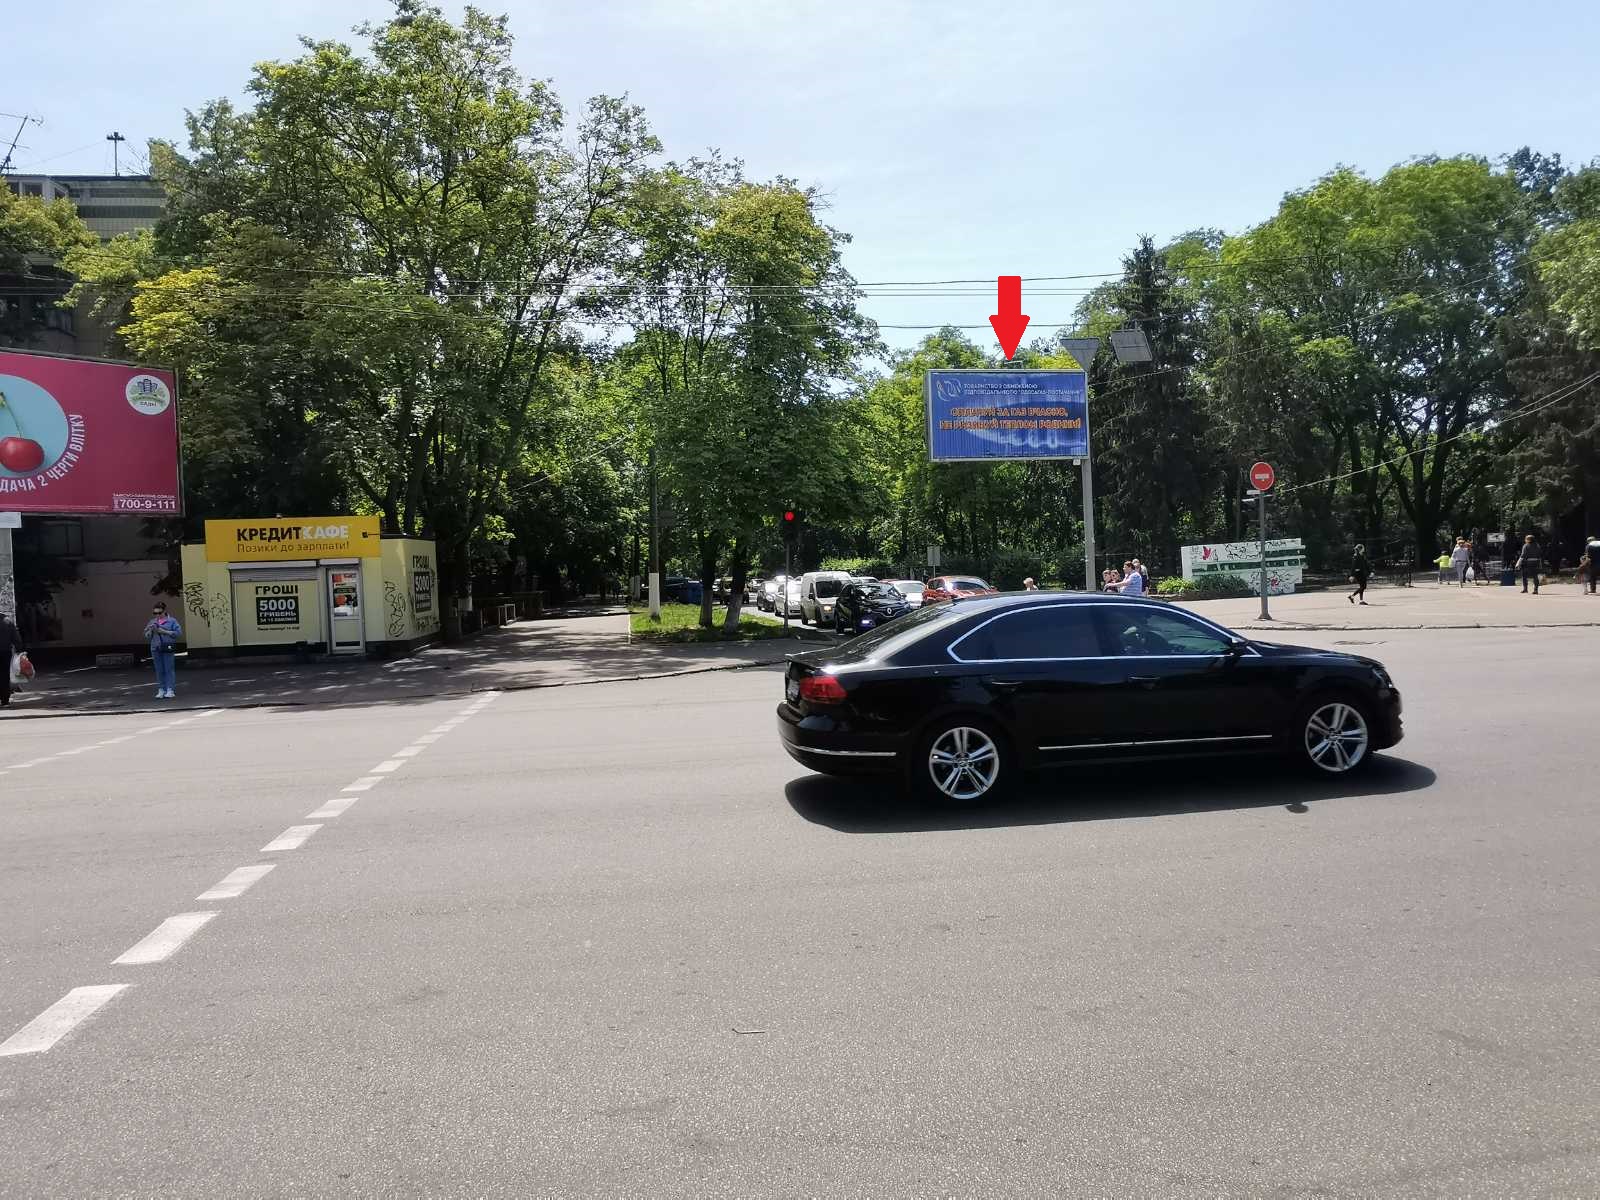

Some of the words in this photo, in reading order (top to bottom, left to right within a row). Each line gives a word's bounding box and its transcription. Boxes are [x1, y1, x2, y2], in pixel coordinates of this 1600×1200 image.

[1011, 407, 1026, 417] ГАЗ
[1027, 407, 1068, 418] ВЧАСНО,
[37, 474, 48, 487] 2
[46, 451, 79, 480] ЧЕРГИ
[68, 414, 86, 452] ВЛІТКУ
[120, 499, 175, 509] 700-9-111
[238, 543, 277, 553] Позики
[280, 544, 294, 553] до
[297, 541, 350, 553] зарплати!
[255, 584, 299, 595] ГРОШІ
[258, 598, 296, 611] 5000
